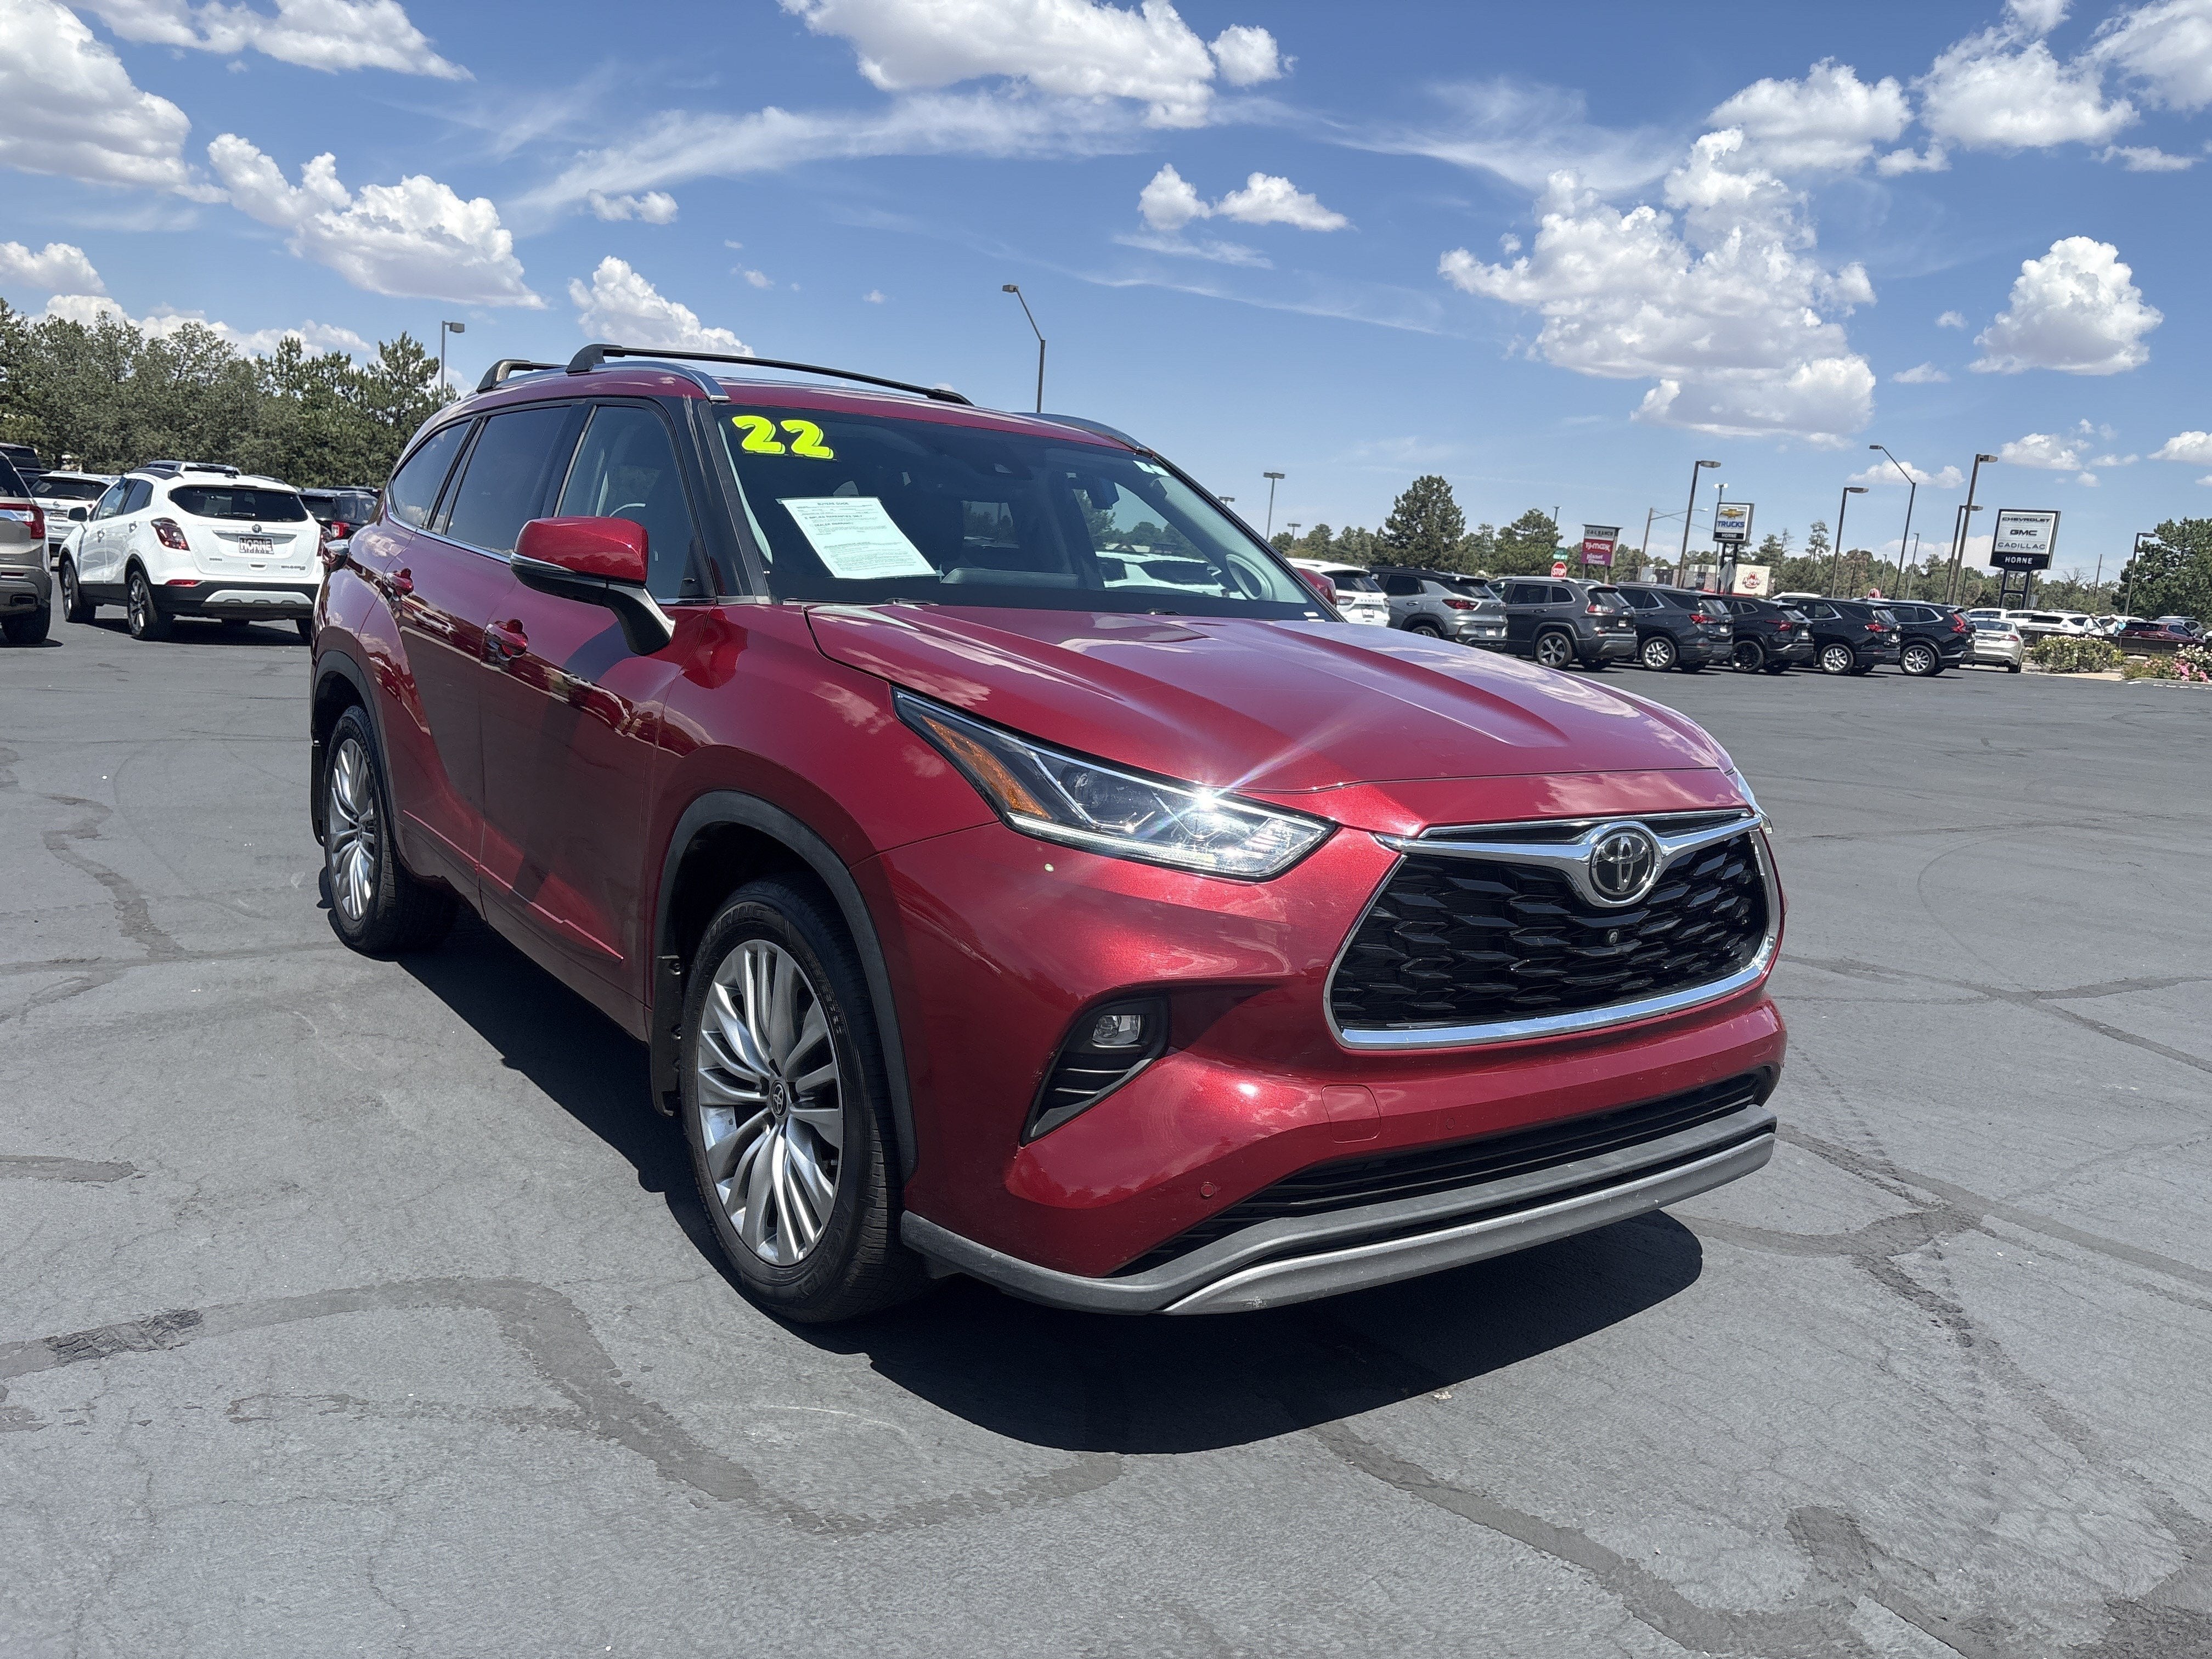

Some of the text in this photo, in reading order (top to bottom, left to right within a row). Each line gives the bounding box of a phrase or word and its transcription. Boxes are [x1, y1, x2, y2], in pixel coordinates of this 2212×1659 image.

[732, 415, 834, 459] 22
[240, 539, 272, 551] HORNE
[2005, 556, 2033, 564] HORNE
[1552, 568, 1565, 576] STOP
